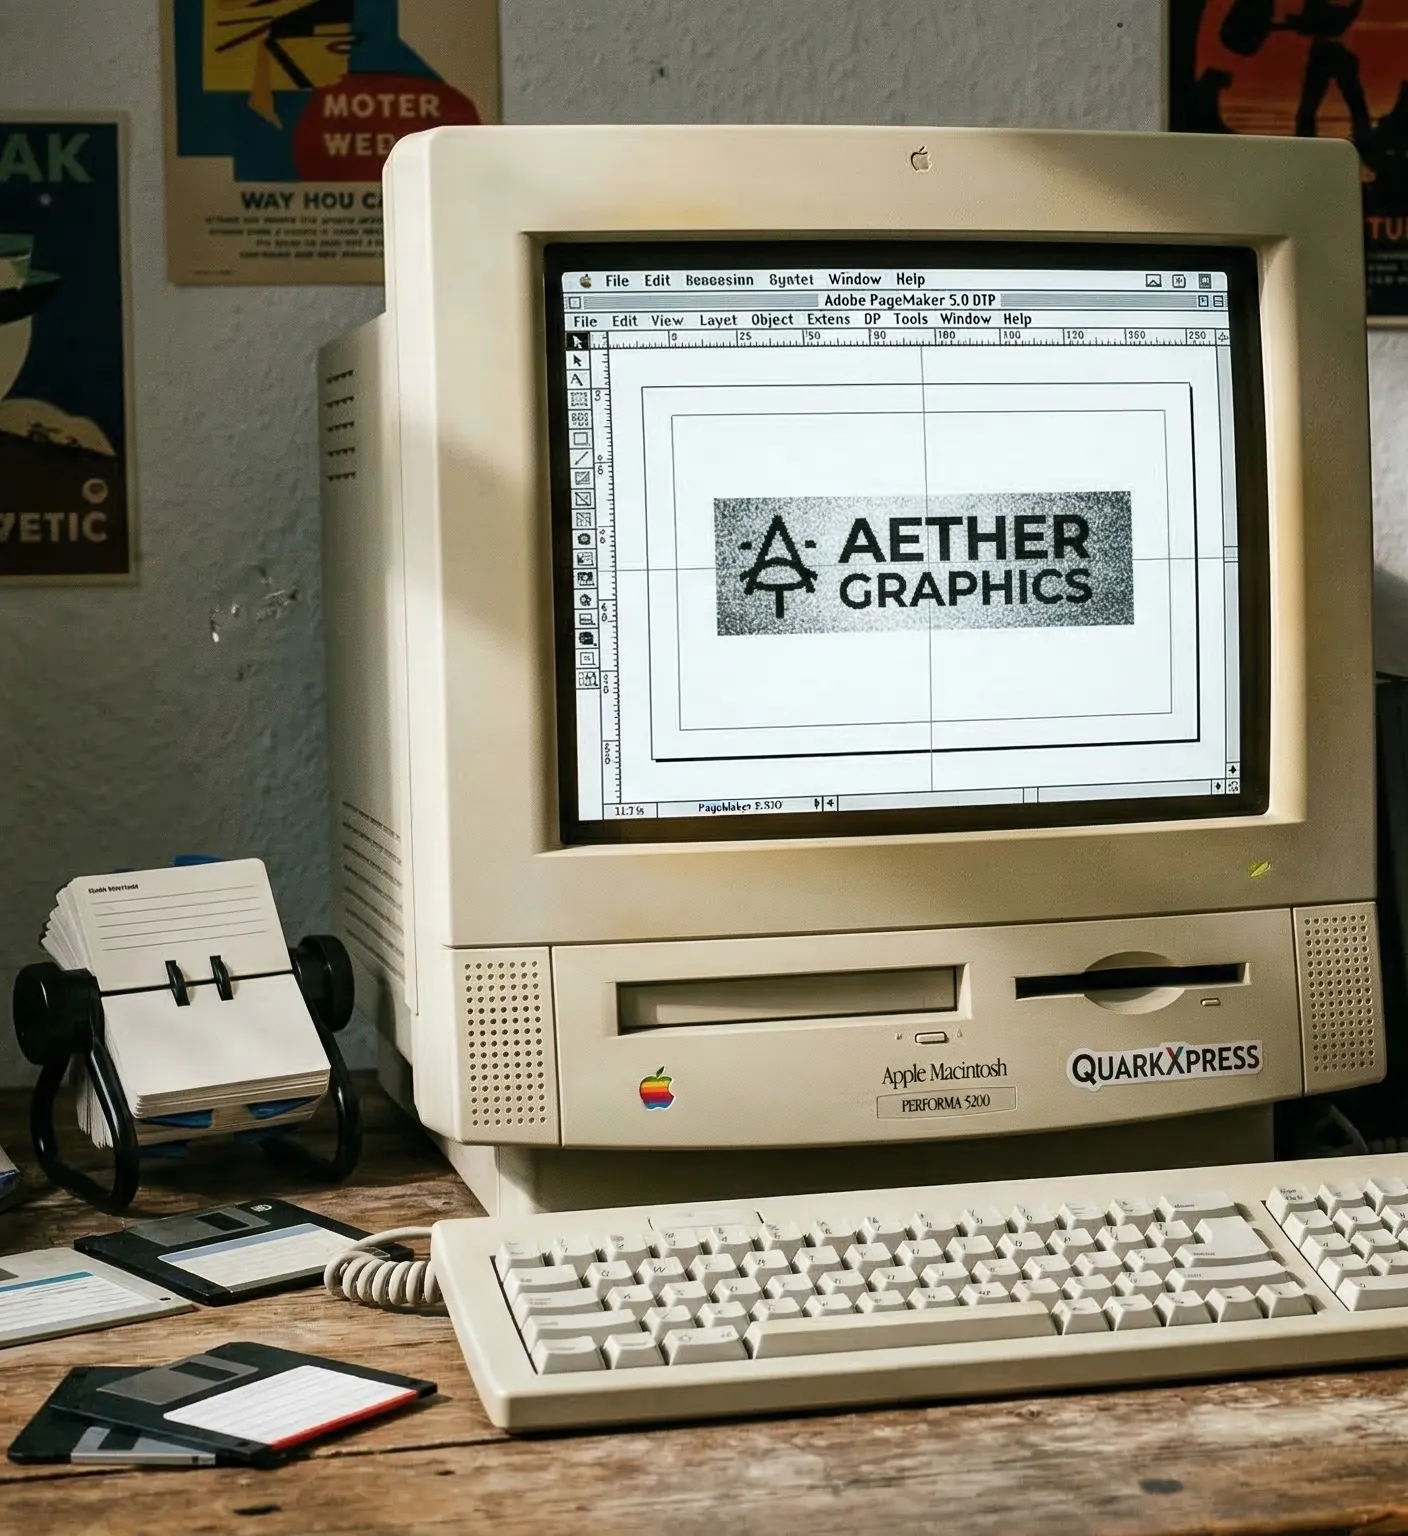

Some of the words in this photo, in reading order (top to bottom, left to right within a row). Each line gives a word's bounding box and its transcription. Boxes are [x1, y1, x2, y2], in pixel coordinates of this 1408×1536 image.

[323, 93, 441, 118] MOTER
[241, 191, 294, 210] WAY
[303, 191, 354, 210] HOU
[605, 274, 630, 287] File
[644, 273, 671, 287] Edit
[828, 272, 882, 286] Window
[824, 293, 866, 307] Adobe
[870, 293, 945, 310] PageMaker
[949, 293, 969, 307] 5.0
[973, 293, 996, 307] DTP
[573, 315, 598, 328] File
[612, 315, 638, 327] Edit
[651, 314, 684, 327] View
[699, 314, 738, 329] Layet
[751, 313, 794, 328] Object
[807, 313, 851, 326] Extens
[864, 312, 881, 325] DP
[893, 312, 928, 325] Tools
[940, 311, 992, 325] Window
[1003, 312, 1032, 328] Help
[838, 515, 1091, 564] AETHER
[839, 568, 1093, 610] GRAPHICS
[881, 1063, 926, 1089] Apple
[930, 1058, 1007, 1081] Macintosh
[1072, 1045, 1260, 1086] QUARKXPRESS
[902, 1096, 962, 1113] PERFORMA
[964, 1094, 991, 1110] 5200
